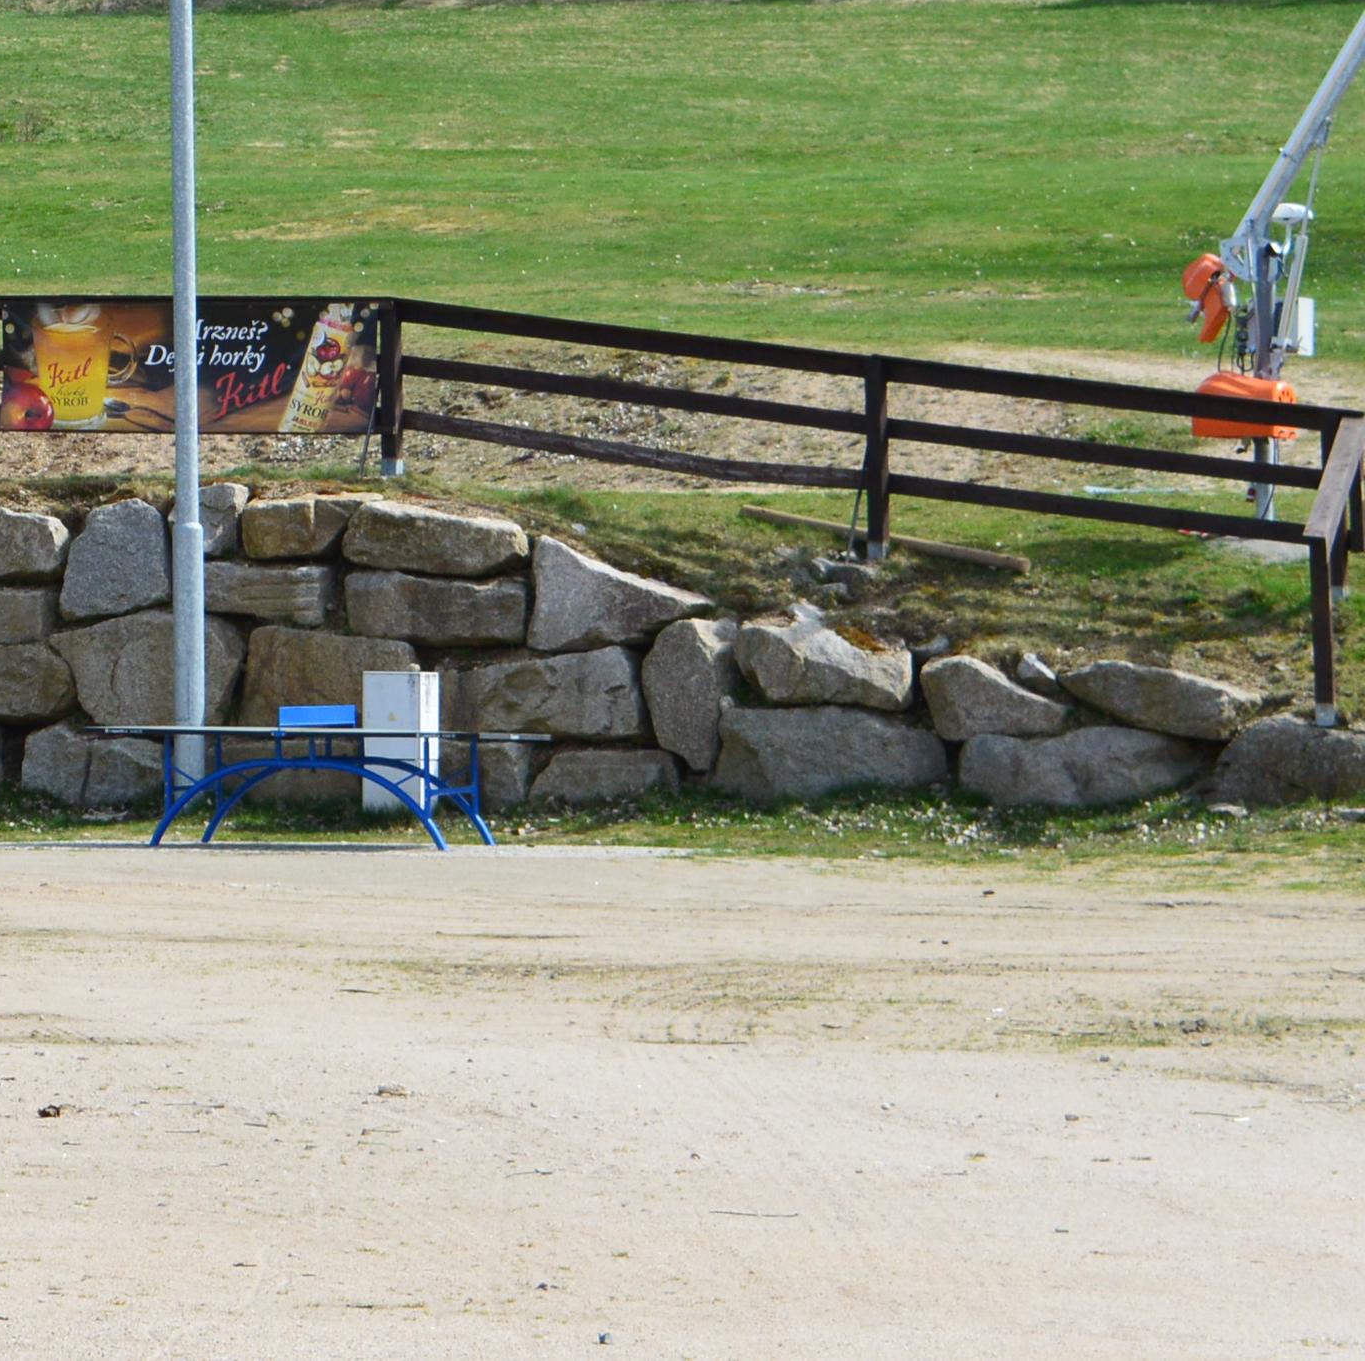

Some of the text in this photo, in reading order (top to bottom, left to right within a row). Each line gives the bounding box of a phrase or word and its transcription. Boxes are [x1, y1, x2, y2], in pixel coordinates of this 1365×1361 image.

[47, 357, 93, 389] Kitl
[209, 344, 266, 373] horký
[214, 362, 287, 420] Kitl
